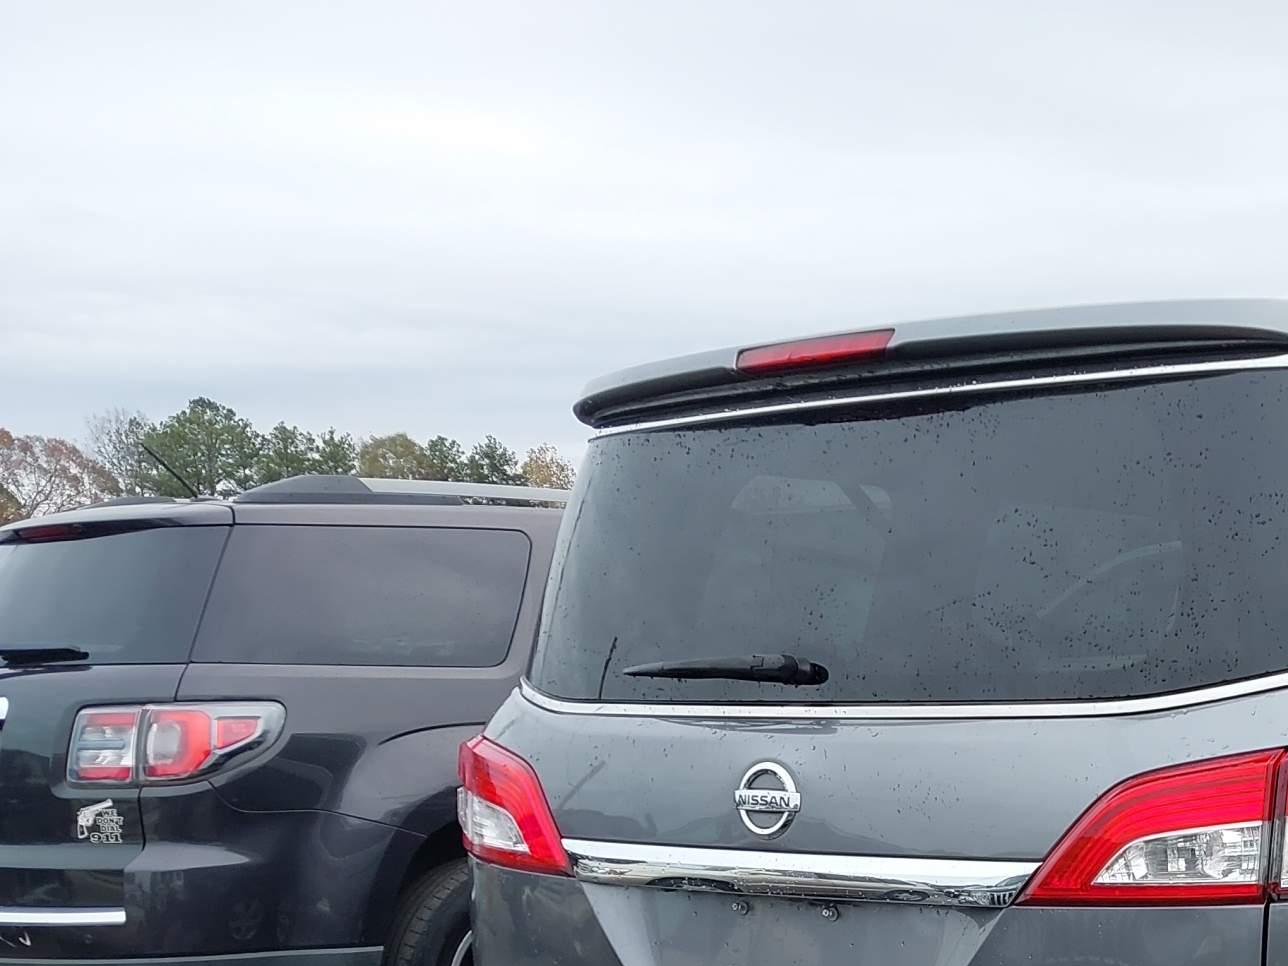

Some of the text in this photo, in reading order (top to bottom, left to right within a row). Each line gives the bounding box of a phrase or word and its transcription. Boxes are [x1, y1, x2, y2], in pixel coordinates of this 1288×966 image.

[738, 794, 790, 807] NISSAN
[101, 809, 117, 817] WE
[100, 824, 122, 833] DIAL
[90, 832, 123, 844] 911
